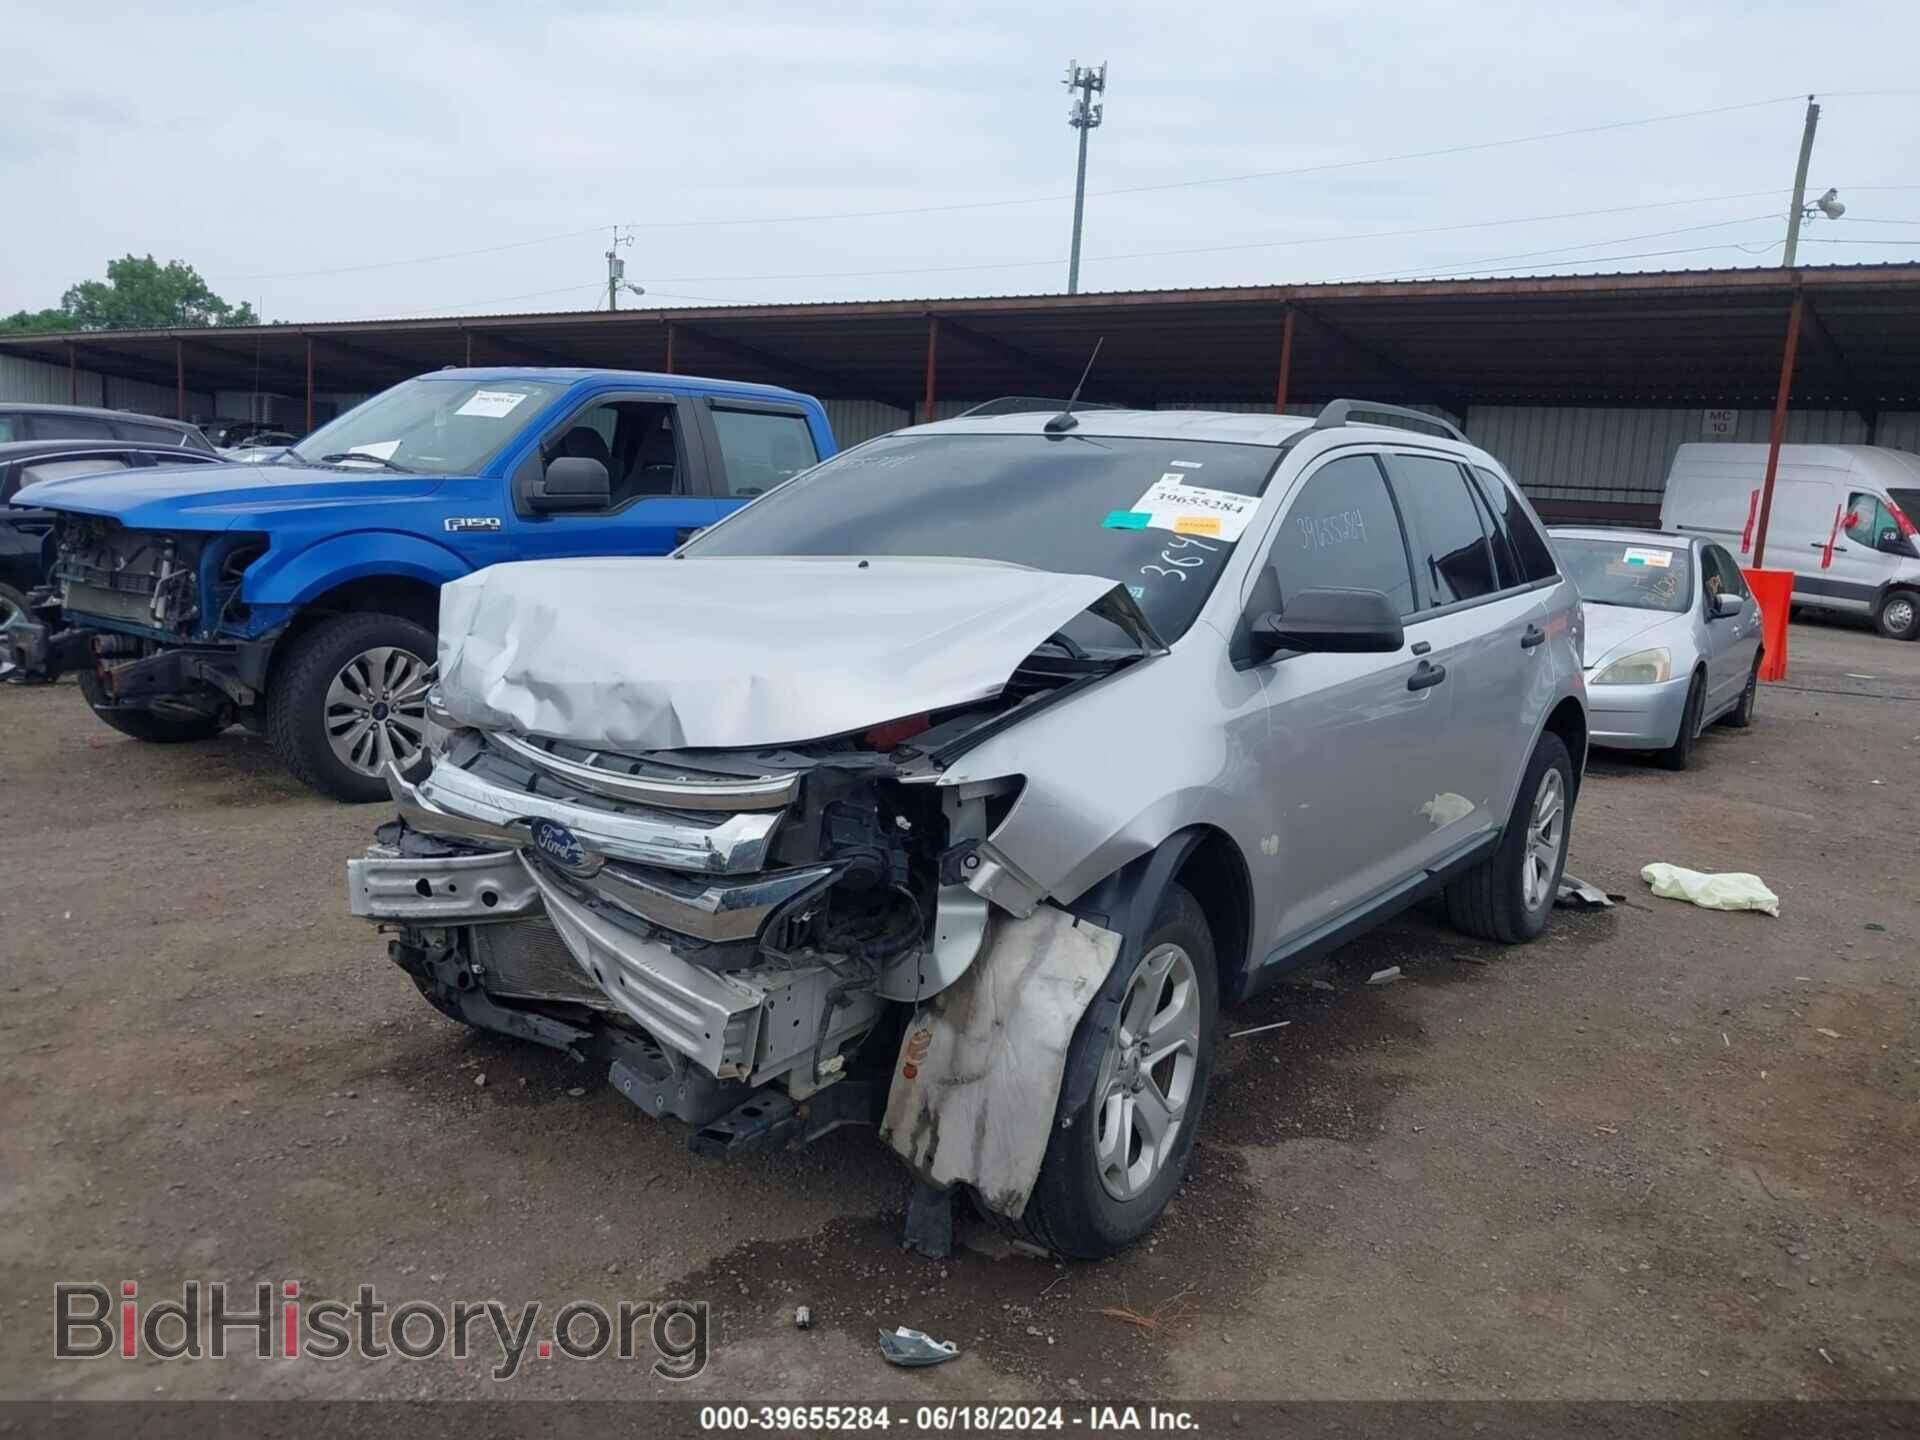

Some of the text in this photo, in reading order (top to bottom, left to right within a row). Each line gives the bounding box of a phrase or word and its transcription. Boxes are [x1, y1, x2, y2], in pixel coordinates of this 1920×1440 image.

[1710, 411, 1732, 421] MC
[1713, 422, 1728, 433] 10
[1153, 494, 1244, 515] 39655284
[538, 823, 571, 860] Ford
